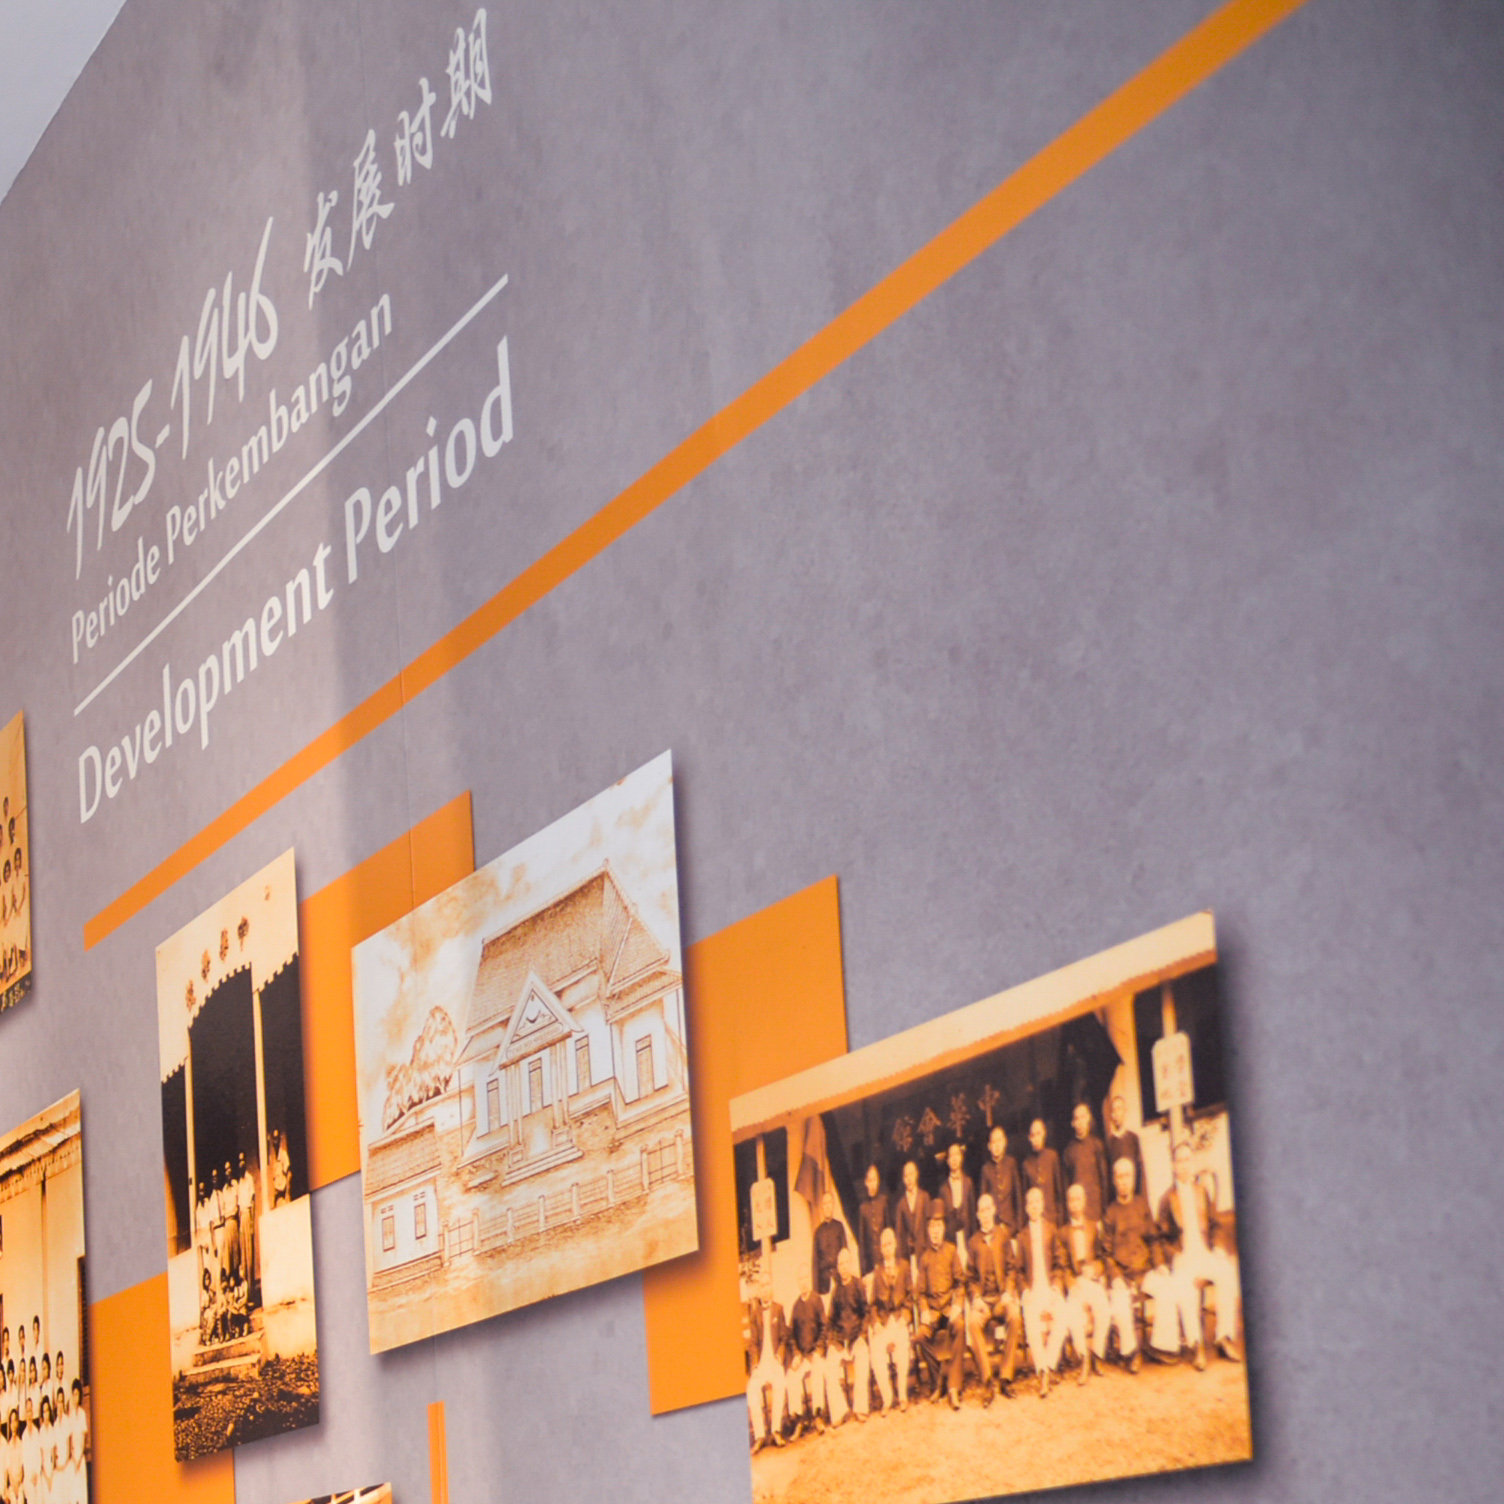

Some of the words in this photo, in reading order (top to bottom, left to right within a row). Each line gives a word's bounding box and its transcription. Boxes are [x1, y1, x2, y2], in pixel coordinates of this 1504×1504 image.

[66, 217, 279, 580] 1925-1946
[72, 537, 162, 664] Periode
[166, 293, 392, 565] Perkembangan
[78, 543, 335, 824] Development
[344, 335, 514, 584] Period
